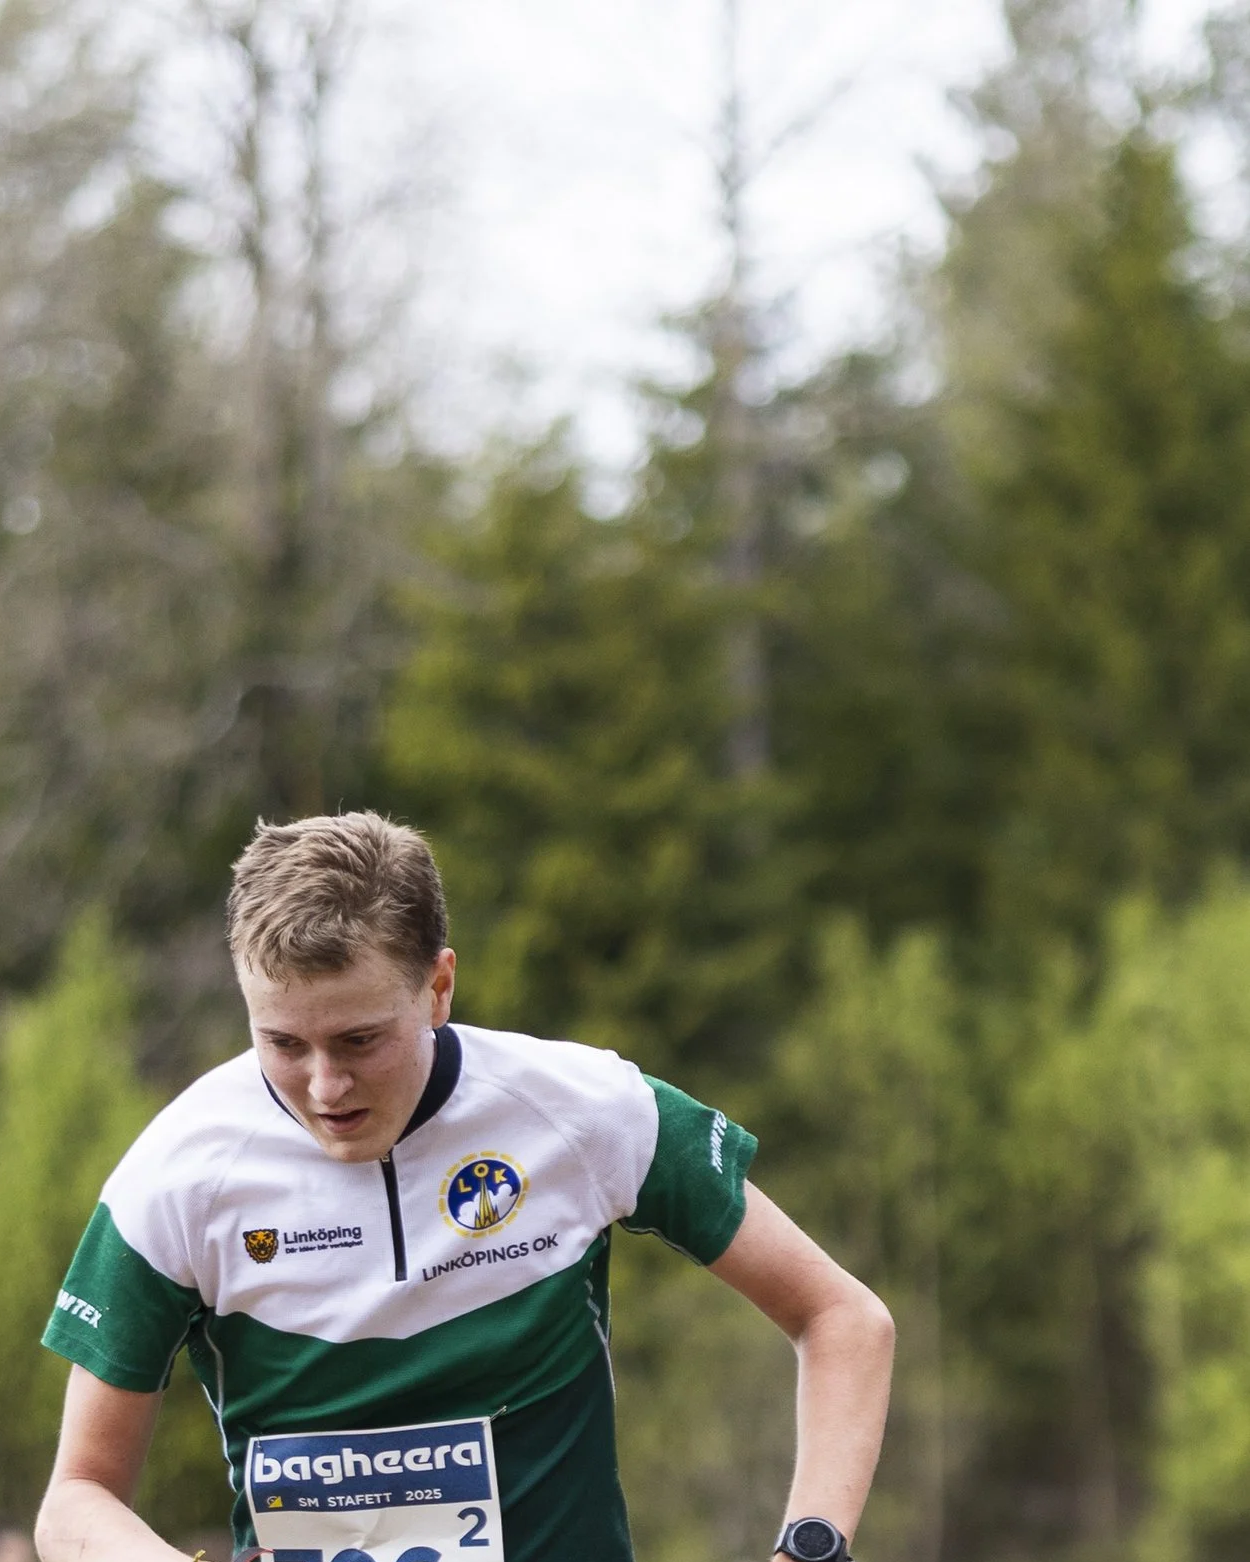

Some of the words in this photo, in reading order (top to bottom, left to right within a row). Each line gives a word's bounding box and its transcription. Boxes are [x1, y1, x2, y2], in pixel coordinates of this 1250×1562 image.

[458, 1162, 508, 1193] LOK
[283, 1226, 362, 1244] Linköping
[422, 1242, 529, 1282] LINKÖPINGS
[533, 1233, 559, 1252] OK
[254, 1441, 483, 1485] bagheera
[298, 1497, 319, 1508] SM
[327, 1492, 392, 1507] STAFETT
[405, 1488, 443, 1501] 2025
[457, 1506, 490, 1547] 2
